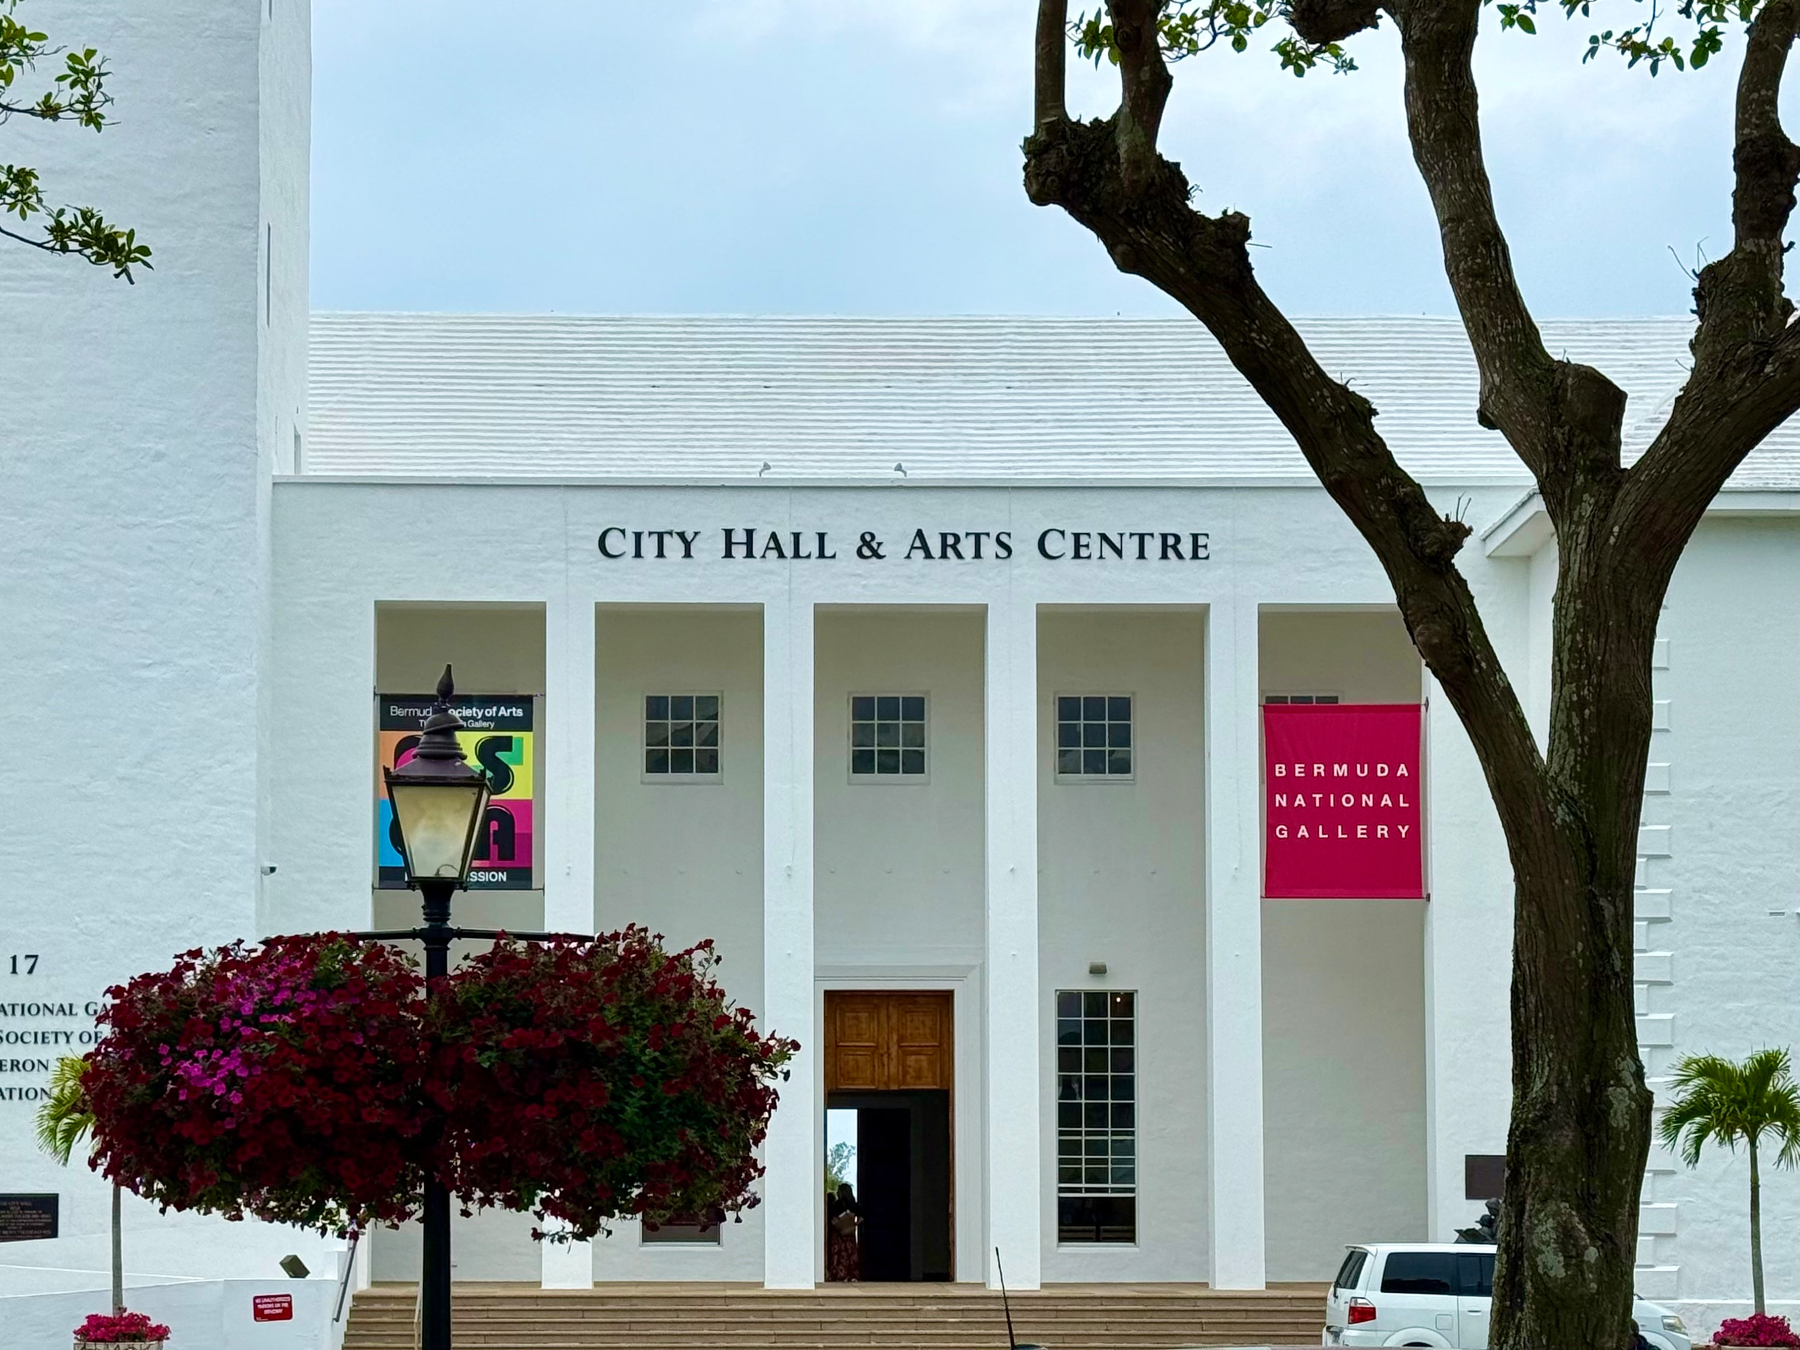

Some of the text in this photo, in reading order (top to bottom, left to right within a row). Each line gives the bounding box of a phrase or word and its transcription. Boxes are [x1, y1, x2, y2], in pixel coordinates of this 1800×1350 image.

[597, 527, 1211, 560] CITY HALL & ARTS CENTRE
[390, 705, 524, 719] Bermud ociety of Arts
[468, 719, 495, 730] Gallery
[1275, 763, 1409, 777] BERMUDA
[1275, 793, 1410, 807] NATIONAL
[1275, 824, 1410, 839] GALLERY
[467, 871, 507, 882] SSION
[10, 954, 39, 975] 17
